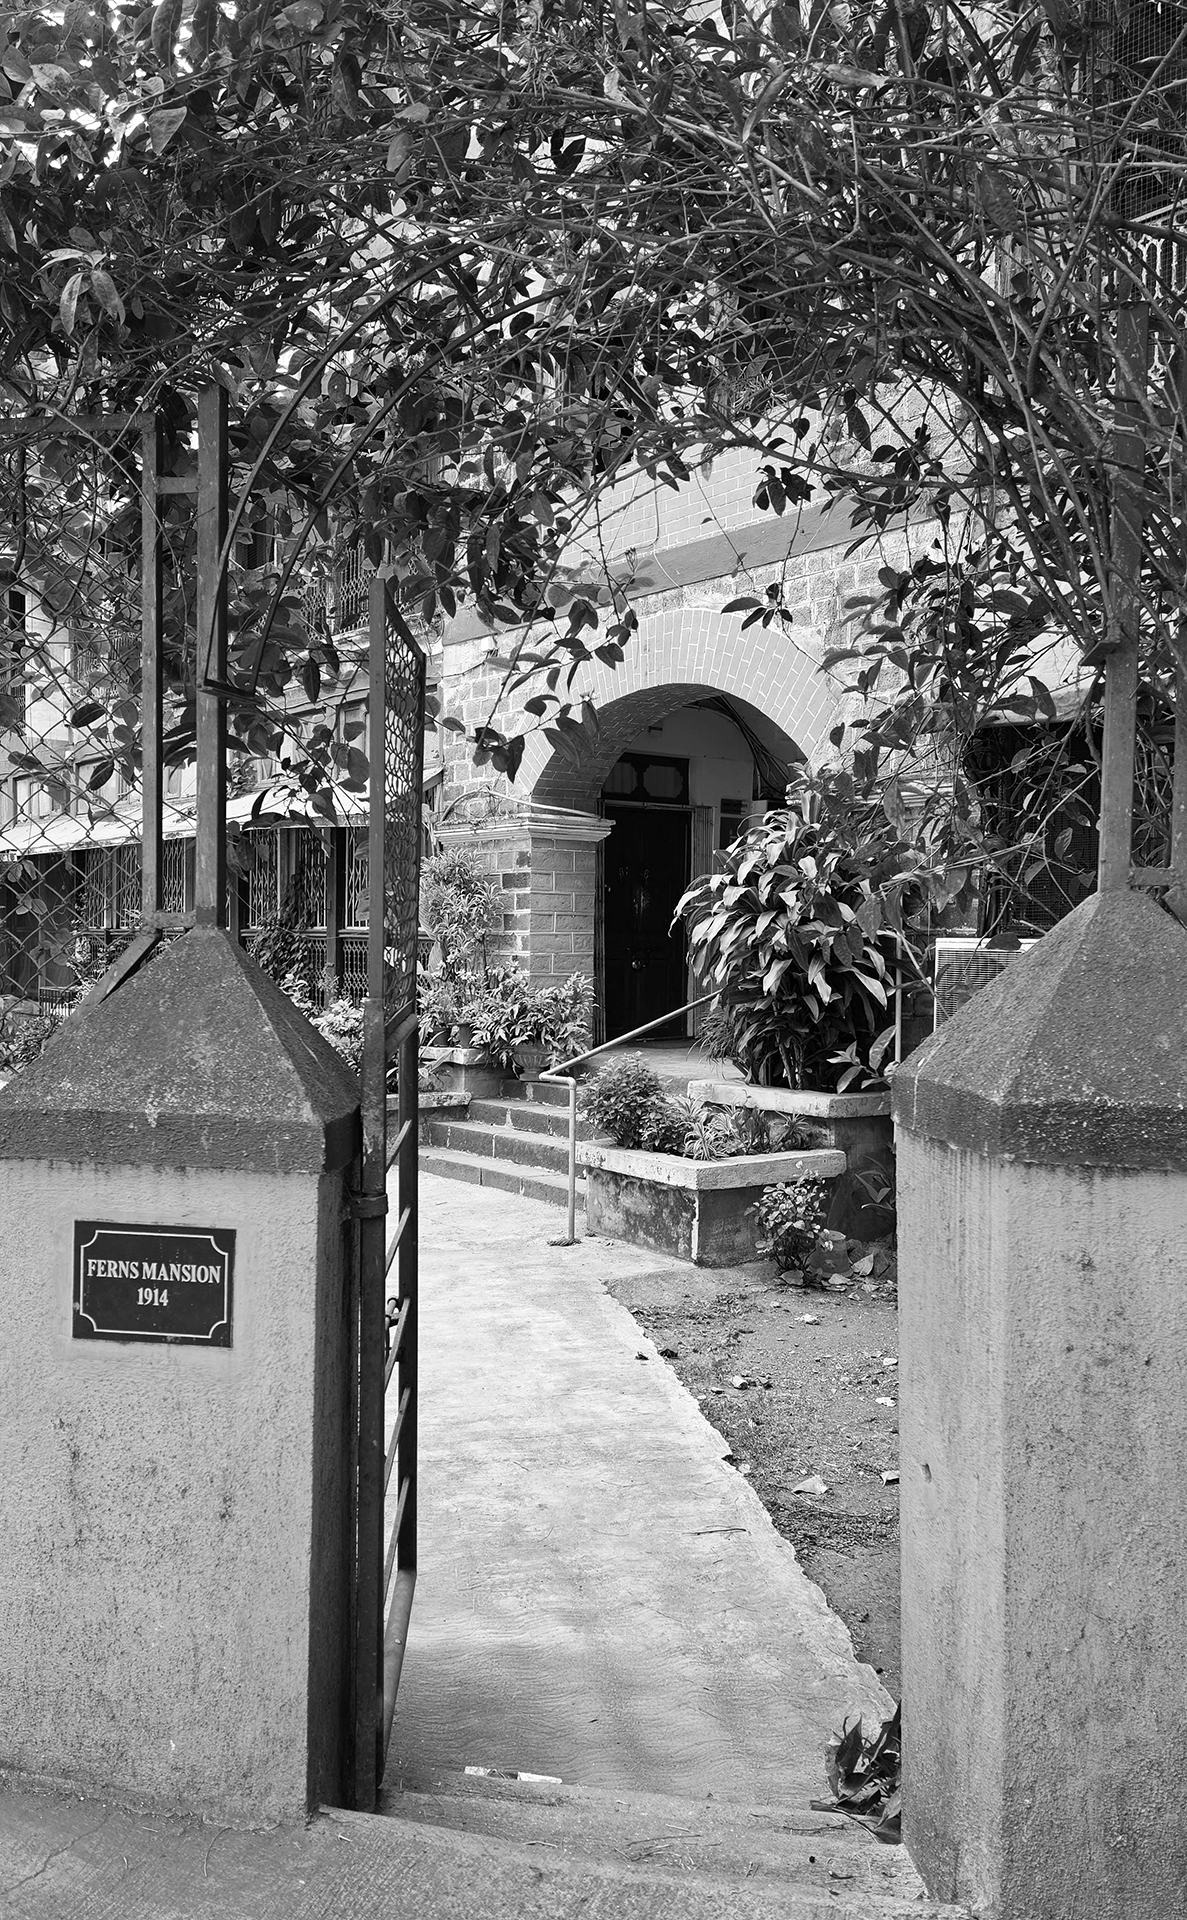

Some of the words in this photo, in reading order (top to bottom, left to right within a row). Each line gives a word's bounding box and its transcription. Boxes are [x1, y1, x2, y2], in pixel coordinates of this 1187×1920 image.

[87, 1259, 139, 1279] FERNS
[142, 1262, 221, 1283] MANSION
[137, 1287, 168, 1306] 1914
